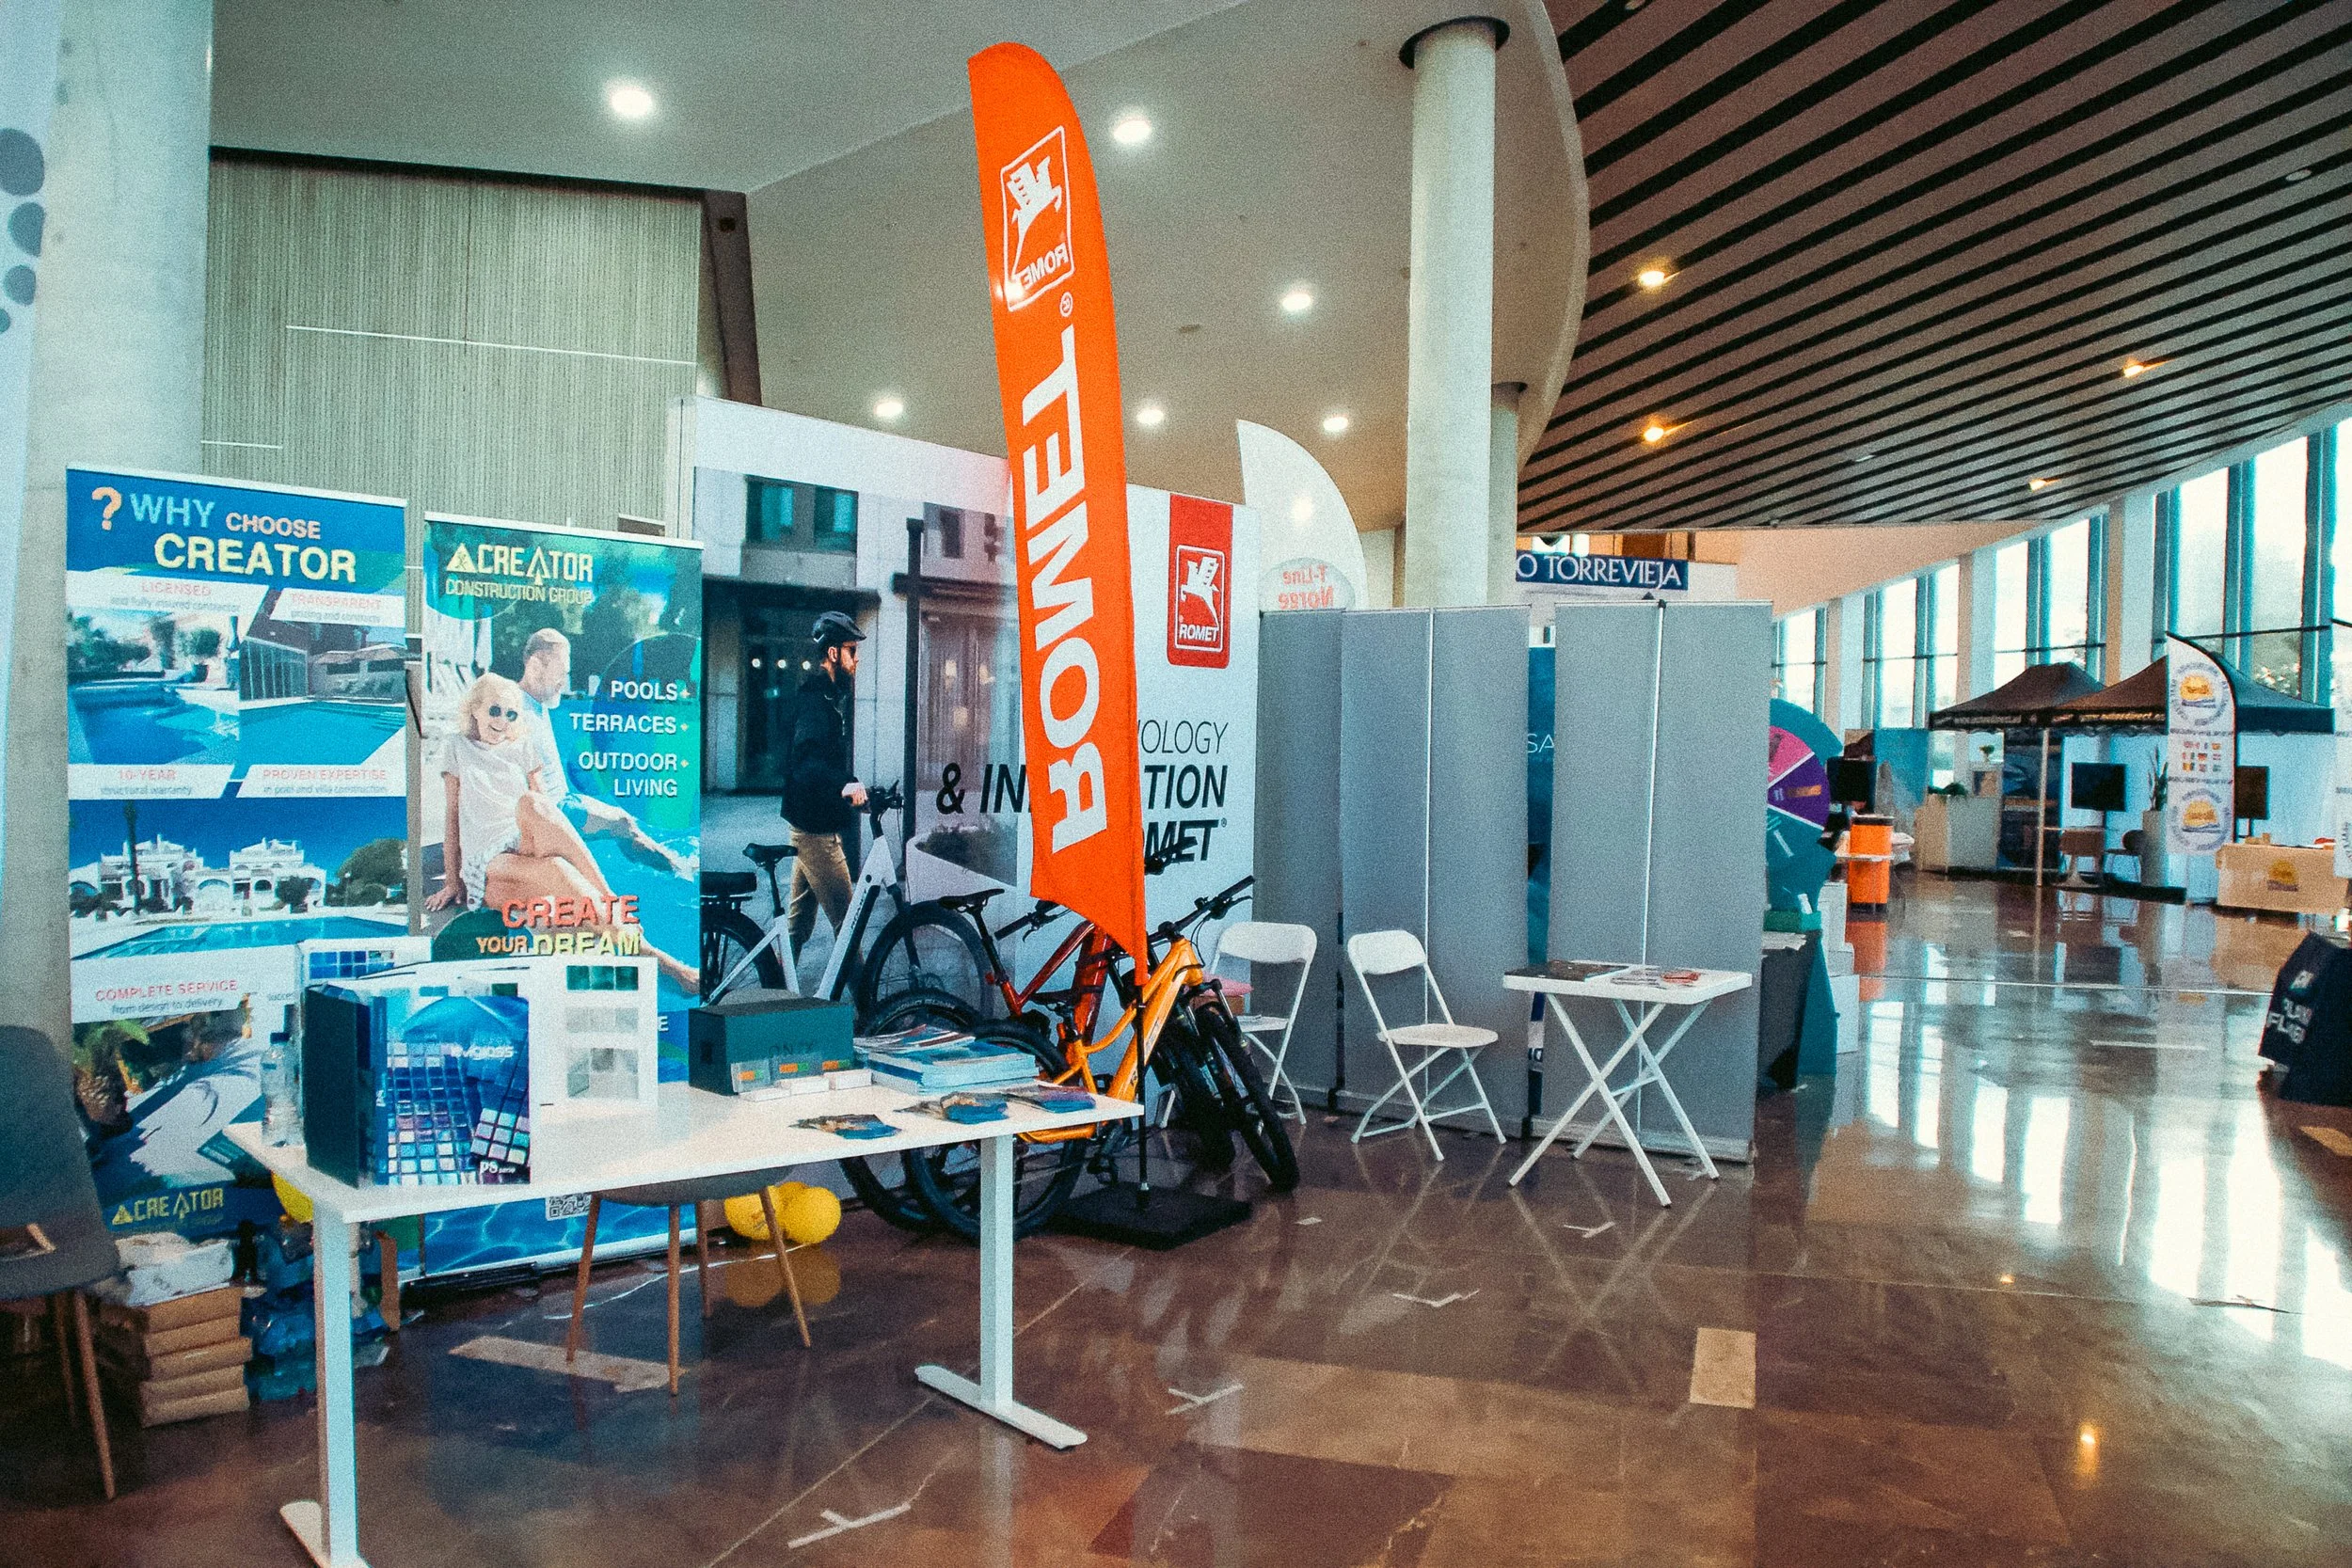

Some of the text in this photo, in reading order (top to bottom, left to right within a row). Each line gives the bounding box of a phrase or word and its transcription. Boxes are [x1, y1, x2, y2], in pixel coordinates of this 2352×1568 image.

[130, 493, 215, 528] WHY
[225, 512, 322, 539] CHOOSE
[154, 533, 357, 583] CREATOR
[477, 544, 594, 586] CREATOR
[1543, 555, 1681, 589] TORREVIEJA
[141, 580, 212, 596] LICENSED
[445, 578, 595, 605] CONSTRUCTION GROUP
[290, 593, 381, 610] TRANSPARENT
[1179, 624, 1219, 642] ROMET
[611, 680, 677, 701] POOLS
[569, 712, 676, 734] TERRACES
[1137, 720, 1229, 754] OLOGY
[578, 751, 677, 771] OUTDOOR
[263, 769, 387, 781] PROVEN EXPERTISE
[613, 778, 677, 797] LIVING
[935, 762, 964, 815] &
[1144, 817, 1221, 862] MET
[501, 895, 640, 928] CREATE
[476, 930, 641, 956] YOUR DREAM
[95, 979, 238, 1003] COMPLETE SERVICE
[133, 1187, 224, 1220] CREATOR
